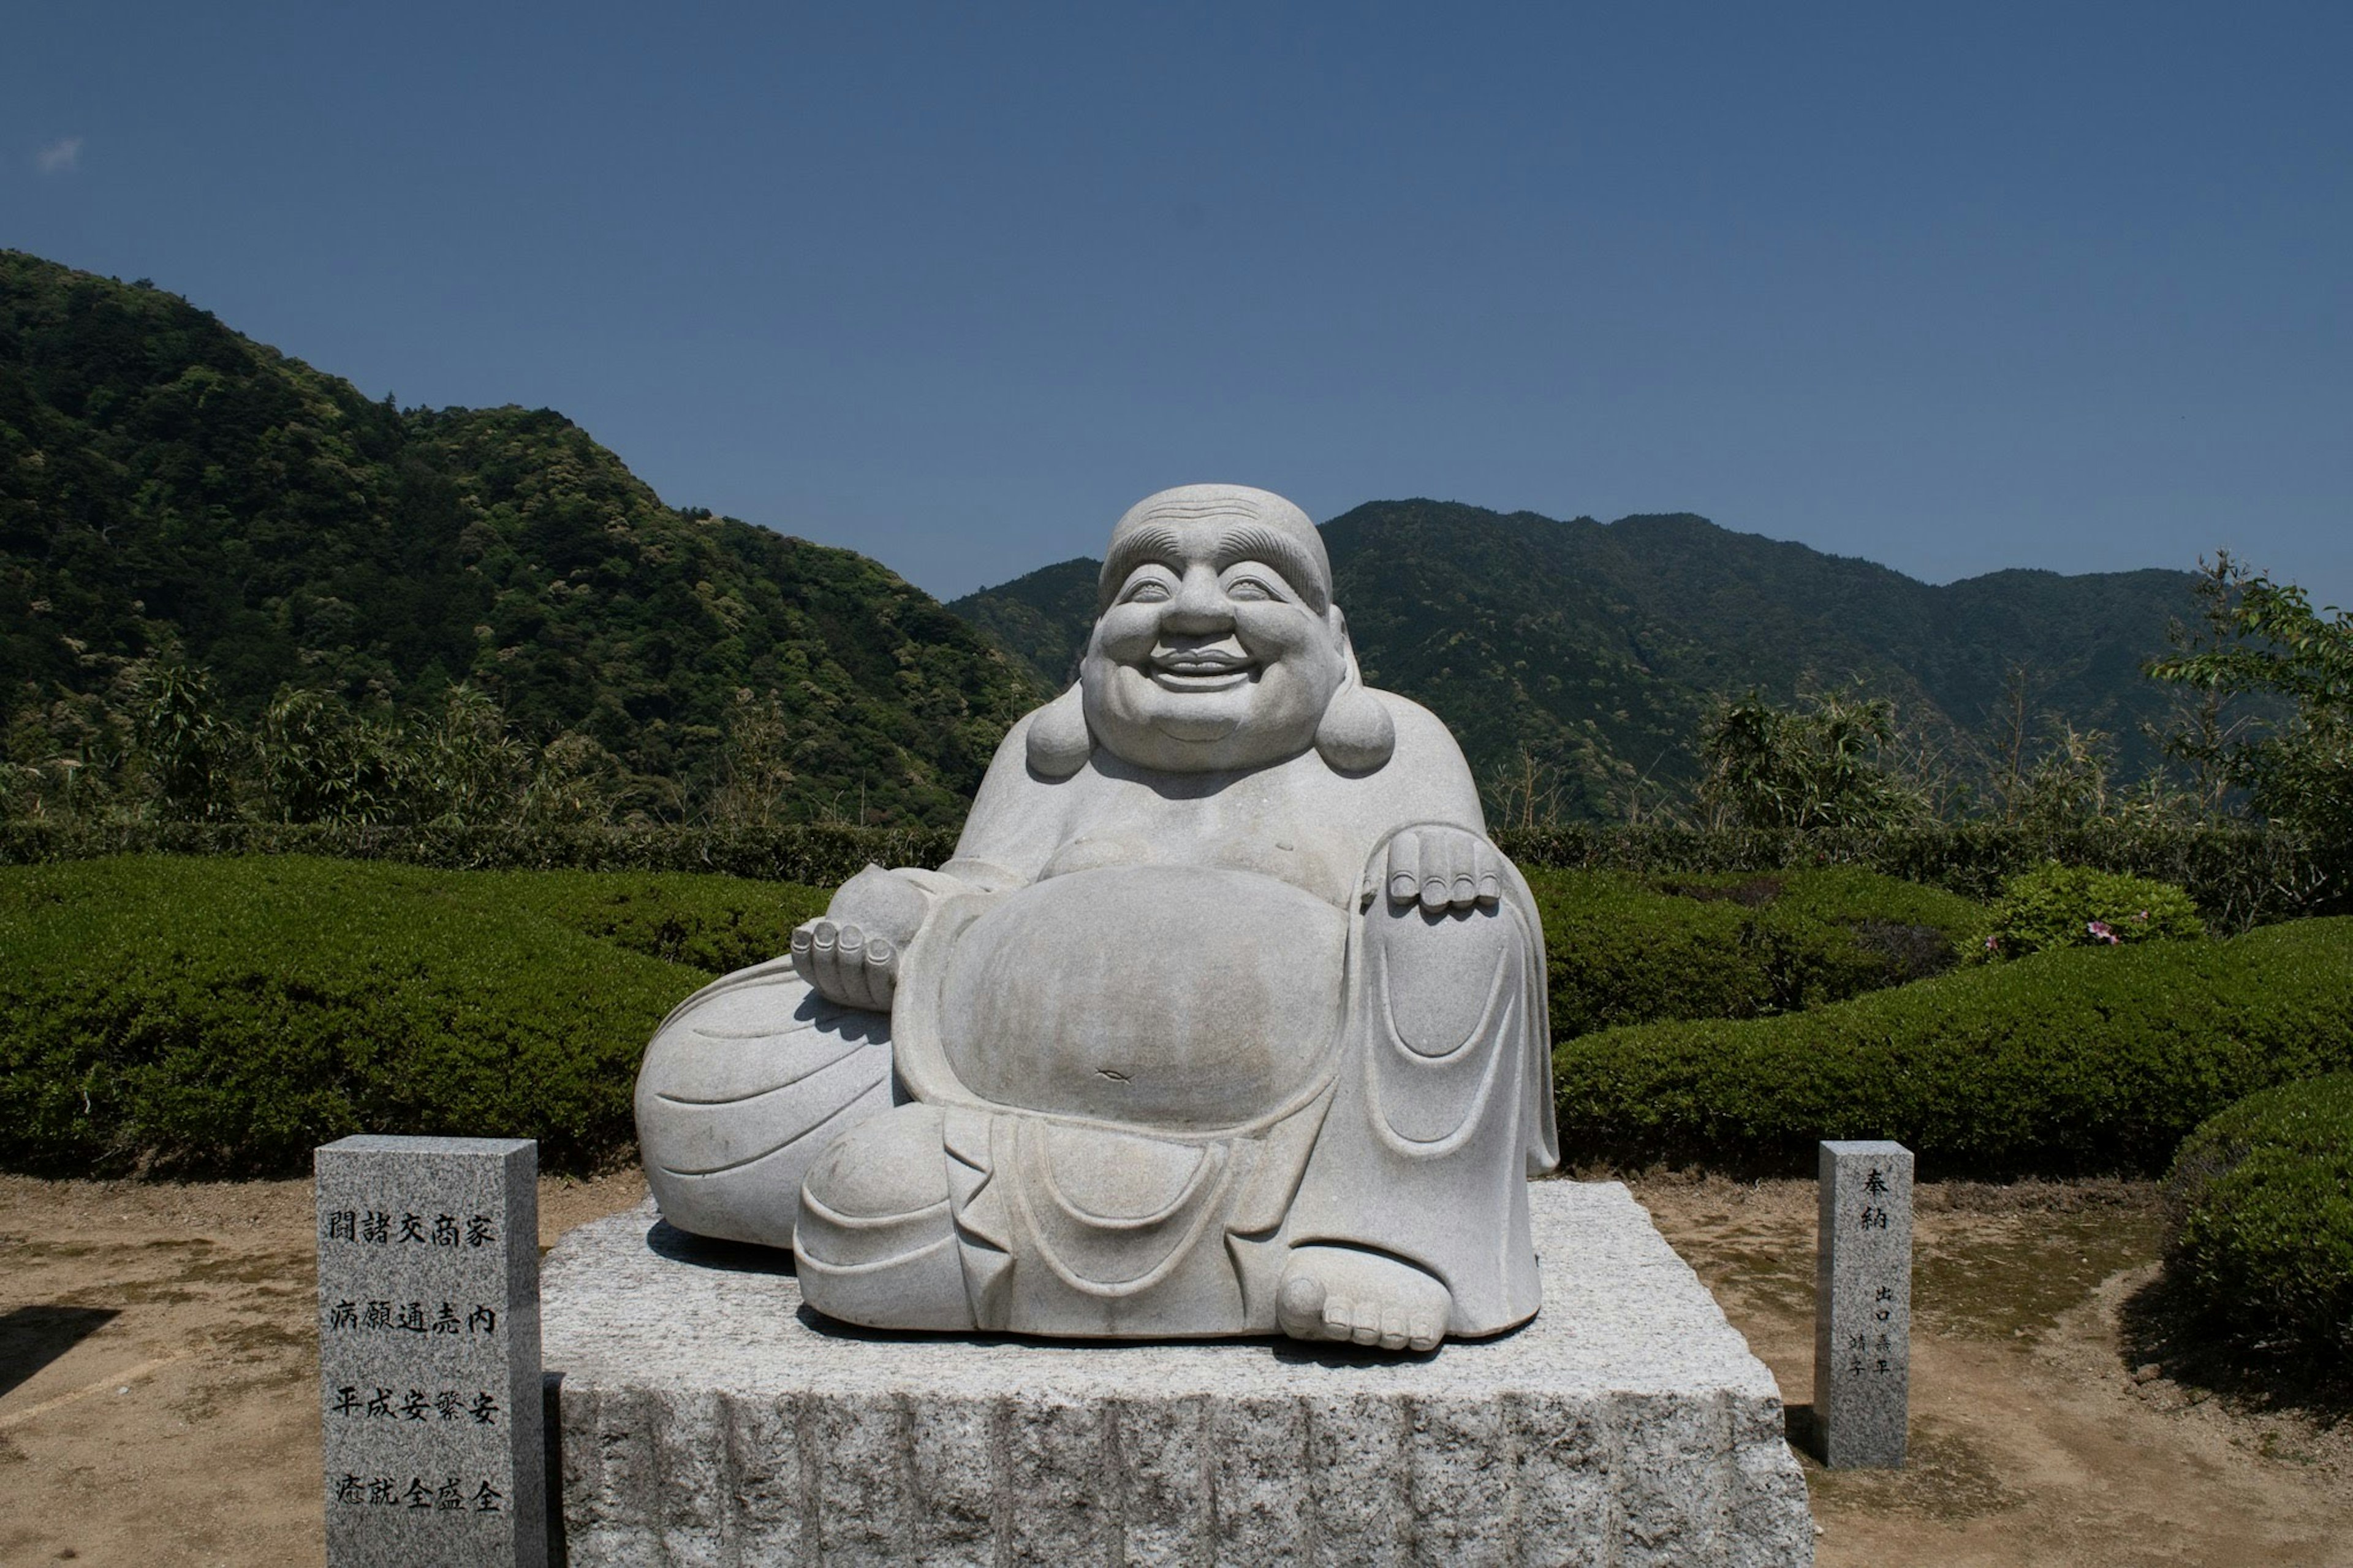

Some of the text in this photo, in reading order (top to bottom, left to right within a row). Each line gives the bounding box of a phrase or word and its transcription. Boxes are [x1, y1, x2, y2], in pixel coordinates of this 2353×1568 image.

[1860, 1169, 1889, 1230] 奉納
[362, 1211, 398, 1505] 諸願成就
[399, 1213, 433, 1509] 交通安全
[433, 1213, 465, 1510] 商売繁盛
[468, 1214, 501, 1512] 家内安全
